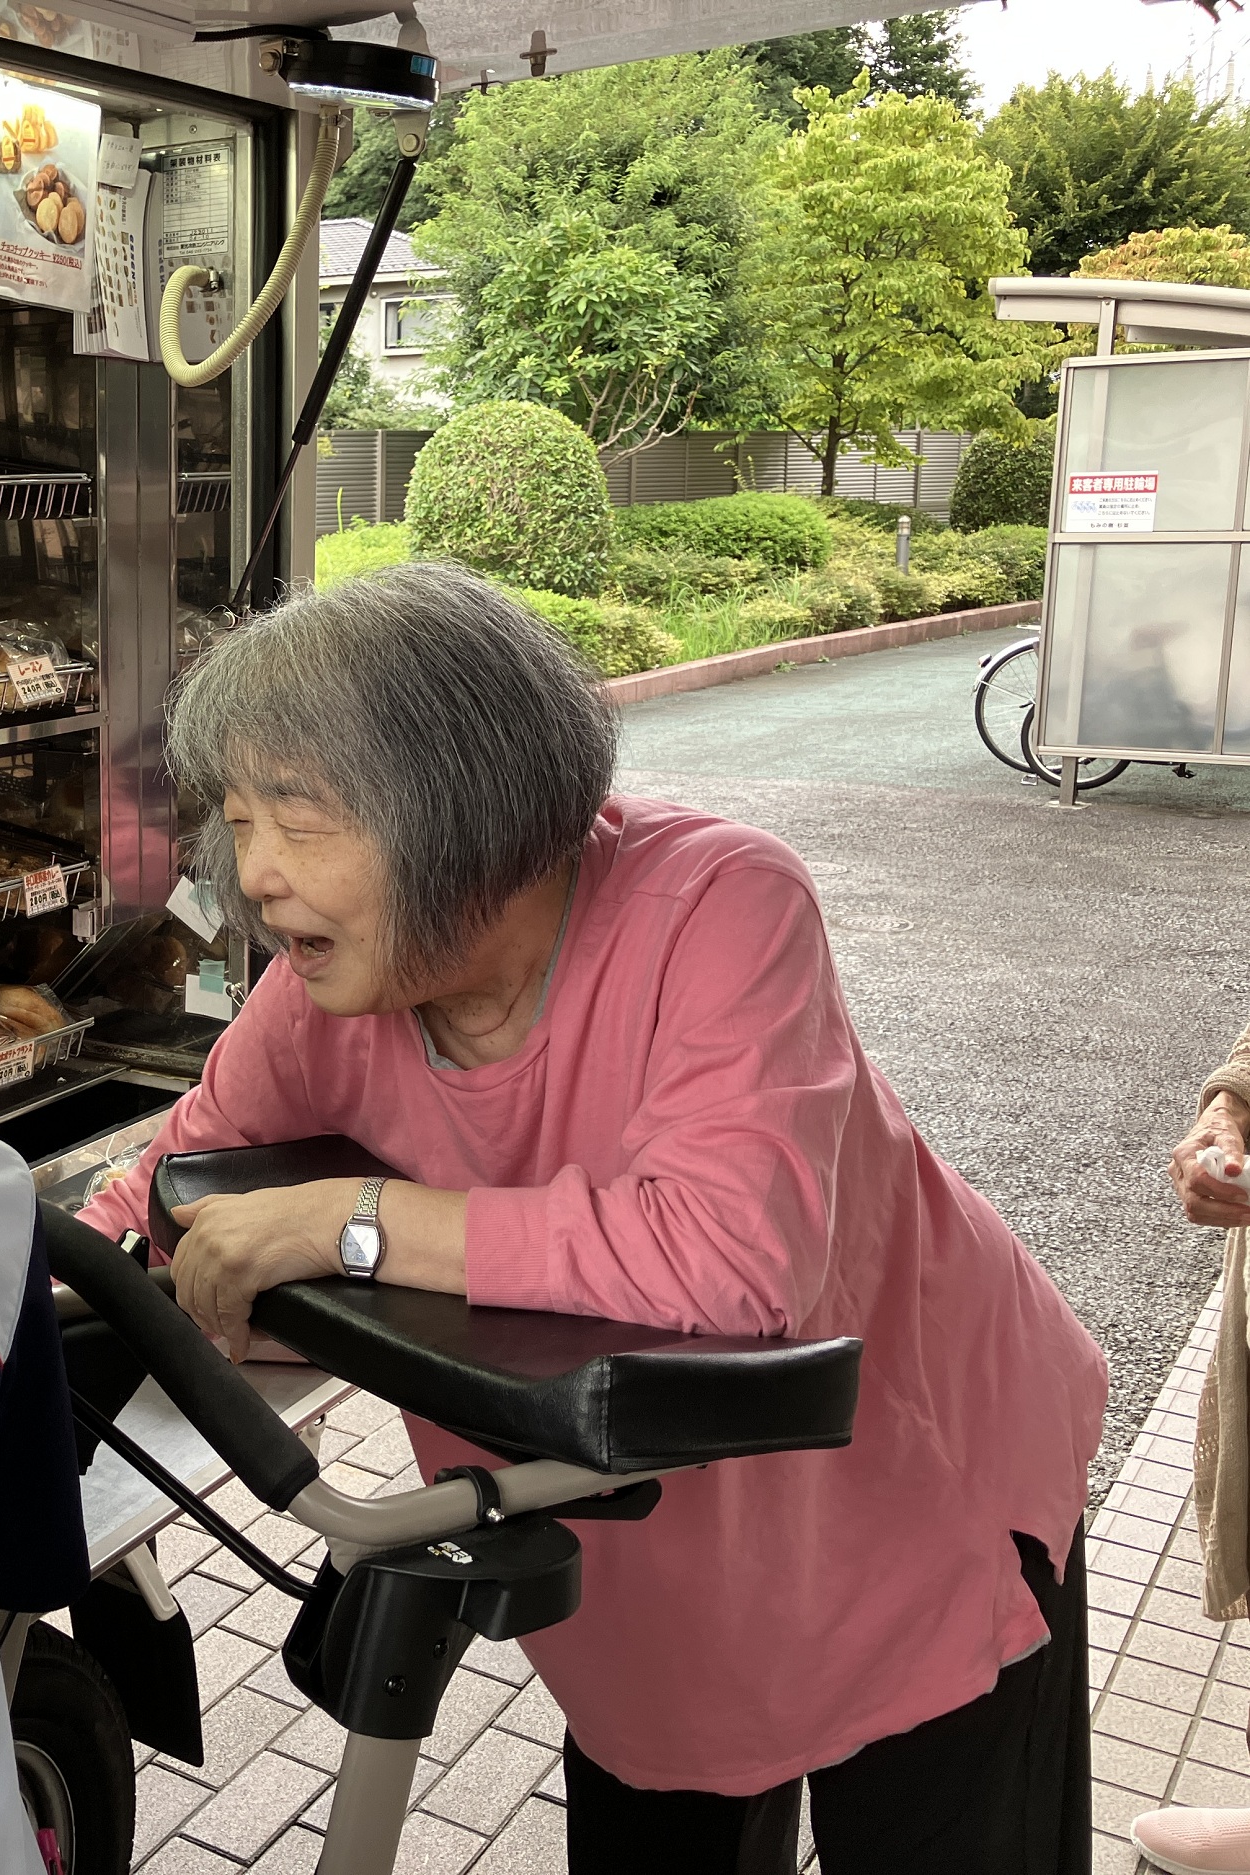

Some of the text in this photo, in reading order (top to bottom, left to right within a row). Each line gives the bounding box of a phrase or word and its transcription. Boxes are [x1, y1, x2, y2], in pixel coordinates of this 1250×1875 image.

[1072, 477, 1156, 491] 来客者専用駐輪場
